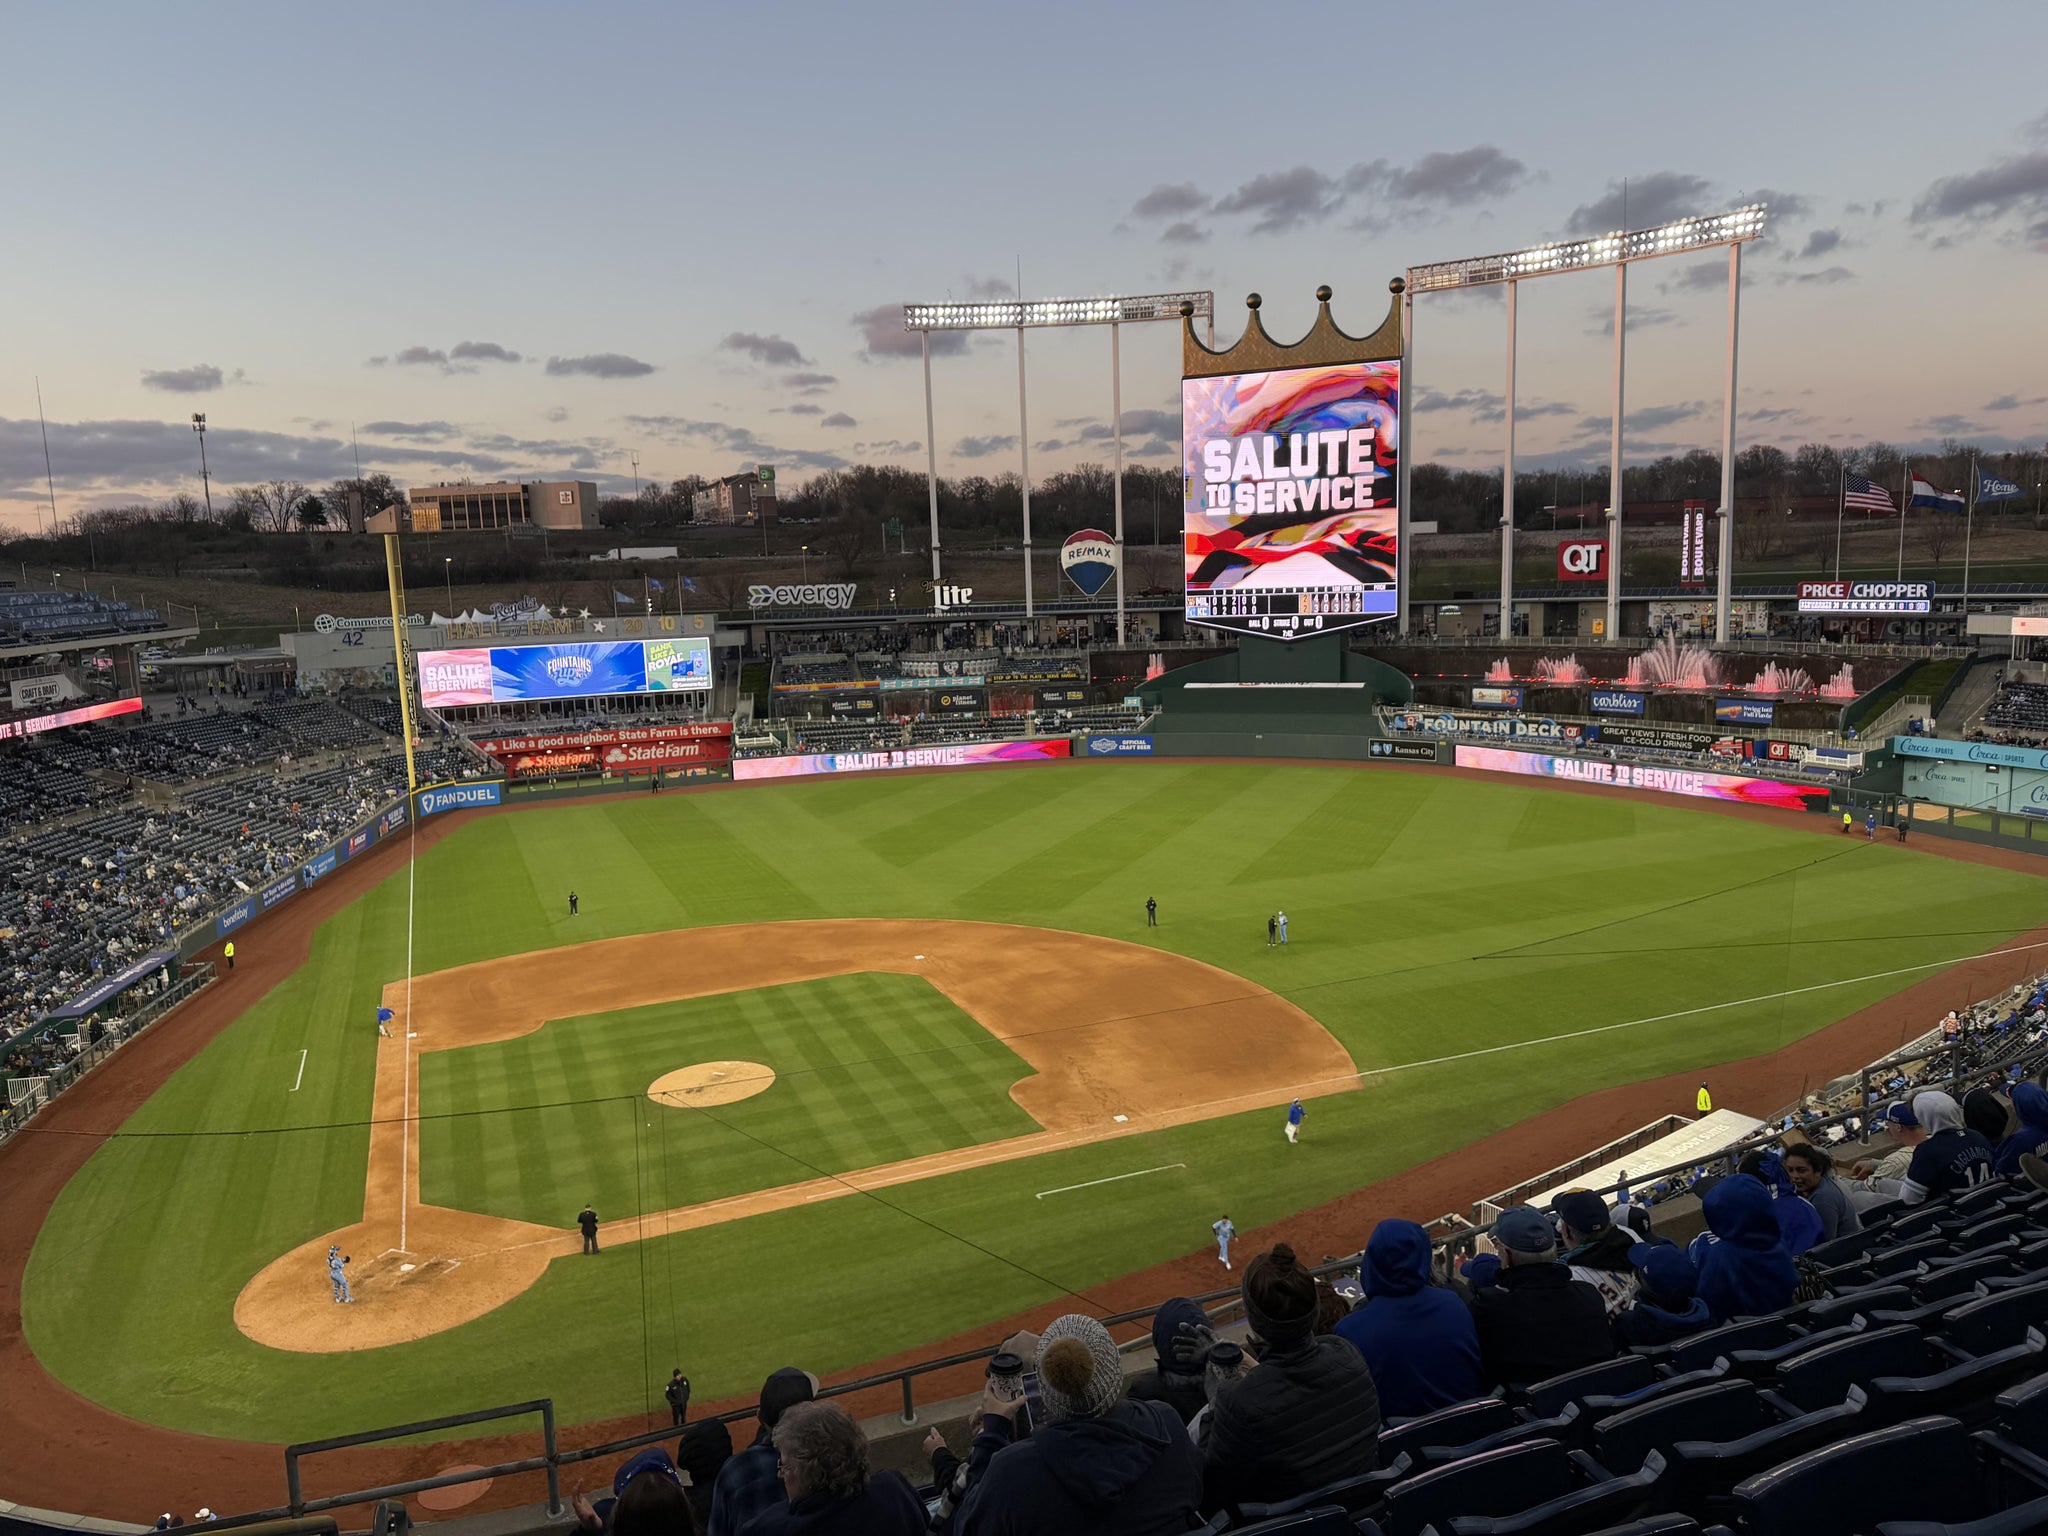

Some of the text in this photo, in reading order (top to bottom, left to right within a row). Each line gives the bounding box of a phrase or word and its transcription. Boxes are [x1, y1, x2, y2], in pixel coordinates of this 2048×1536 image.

[1203, 428, 1375, 482] SALUTE
[1205, 475, 1375, 515] TO SERVICE
[1983, 480, 2020, 496] Home
[1681, 513, 1689, 576] BOULEVARD
[1694, 513, 1704, 576] BOULEVARD
[1068, 547, 1111, 560] RE/MAX
[1563, 544, 1602, 574] QT
[776, 585, 855, 608] evergy
[933, 585, 973, 610] Lite
[1212, 596, 1217, 605] 0
[1222, 596, 1227, 605] 0
[1232, 596, 1236, 605] 2
[1242, 596, 1247, 605] 0
[1252, 596, 1257, 605] 0
[1313, 594, 1319, 602] 4
[1334, 593, 1339, 602] 4
[1355, 593, 1360, 601] 2
[1802, 584, 1927, 598] PRICE CHOPPER
[490, 595, 538, 620] Royals
[1212, 606, 1217, 615] 0
[1222, 606, 1227, 615] 2
[1232, 606, 1237, 615] 0
[1242, 606, 1247, 615] 0
[1252, 605, 1257, 614] 0
[336, 616, 393, 628] Commerce
[447, 620, 504, 639] HALL
[527, 618, 585, 636] FAME
[624, 618, 643, 633] 20
[659, 616, 675, 631] 10
[694, 615, 704, 629] 5
[1262, 616, 1269, 629] 0
[1291, 616, 1299, 629] 0
[1315, 615, 1323, 628] 0
[342, 631, 364, 646] 42
[650, 641, 672, 654] BANK
[650, 648, 675, 661] LIKE A
[547, 656, 592, 675] FOUNTAINS
[648, 652, 684, 672] ROYAL
[426, 664, 485, 681] SALUTE
[22, 687, 37, 699] CRAFT
[42, 684, 57, 696] DRAFT
[438, 678, 485, 691] SERVICE
[1593, 693, 1640, 708] carbliss
[25, 715, 57, 733] SERVICE
[1424, 718, 1510, 735] FOUNTAIN
[1516, 723, 1562, 737] DECK
[1566, 727, 1577, 737] QT
[502, 741, 525, 750] Like
[538, 737, 564, 750] good
[567, 733, 616, 748] neighbor,
[619, 731, 647, 740] State
[650, 728, 677, 738] Farm
[680, 727, 689, 735] is
[692, 724, 721, 734] there.
[1603, 727, 1711, 743] GREAT VIEWS FRESH FOOD
[1623, 736, 1693, 749] ICE-COLD DRINKS
[628, 743, 699, 761] StateFarm
[1395, 746, 1434, 757] Kansas City
[1771, 743, 1785, 756] QT
[1900, 738, 1953, 755] Circa SPORTS
[1969, 745, 2024, 763] Circa SPORTS
[535, 751, 594, 767] StateFarm
[835, 752, 889, 770] SALUTE
[906, 748, 964, 765] SERVICE
[1554, 759, 1612, 782] SALUTE
[1633, 769, 1704, 792] SERVICE
[1925, 768, 1947, 780] Circa
[436, 789, 495, 807] FANDUEL
